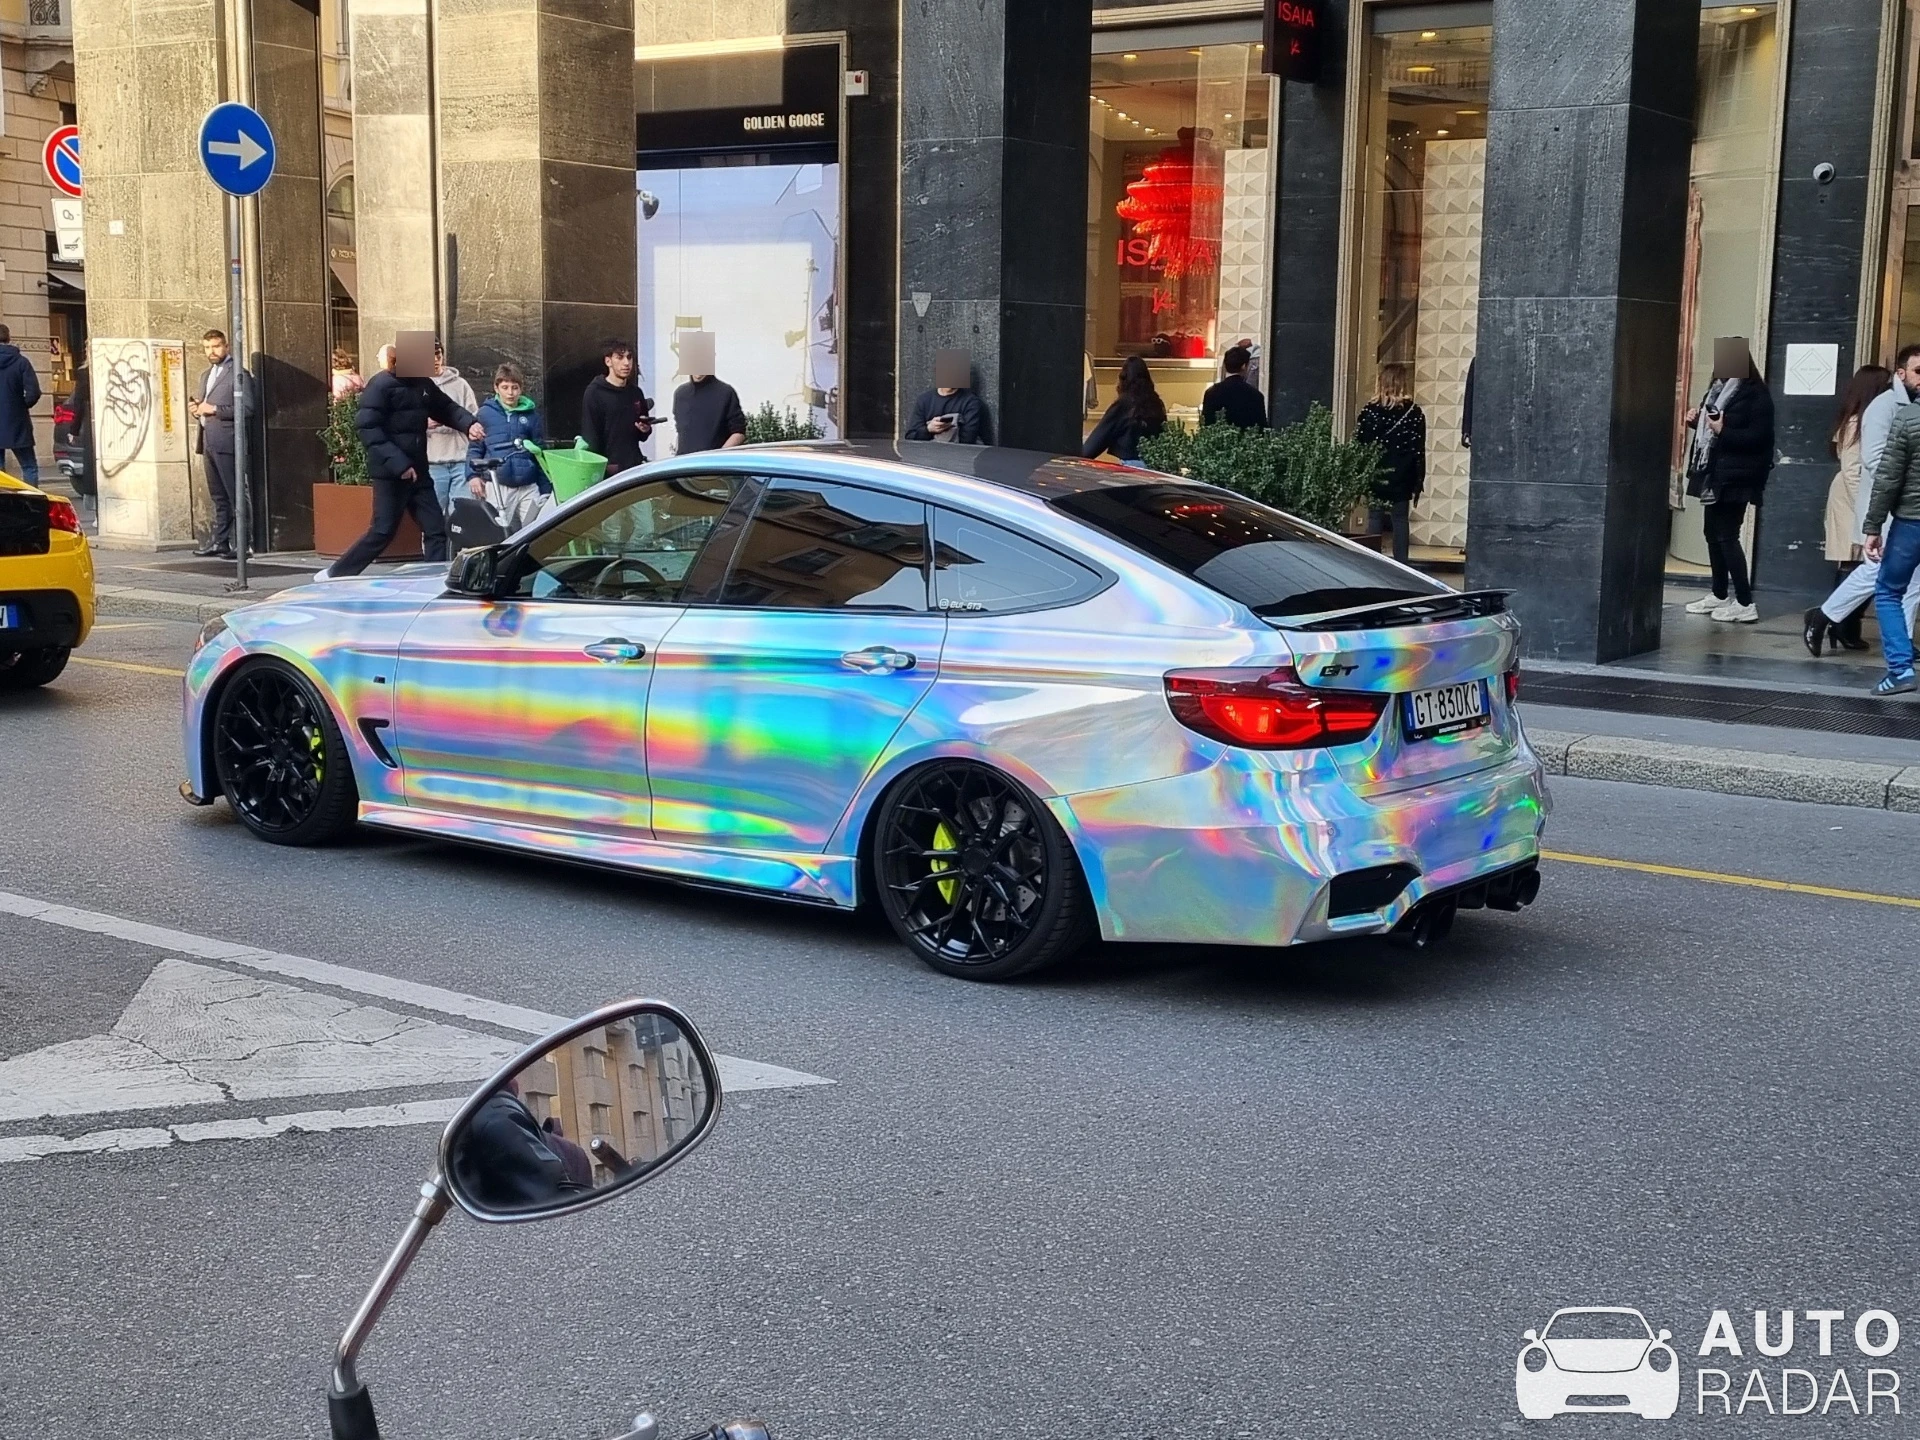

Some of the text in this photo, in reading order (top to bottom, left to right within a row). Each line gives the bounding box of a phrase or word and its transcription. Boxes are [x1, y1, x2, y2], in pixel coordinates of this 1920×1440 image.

[1278, 0, 1314, 27] ISAIA
[743, 113, 825, 130] GOLDEN GOOSE
[1319, 664, 1359, 677] GT
